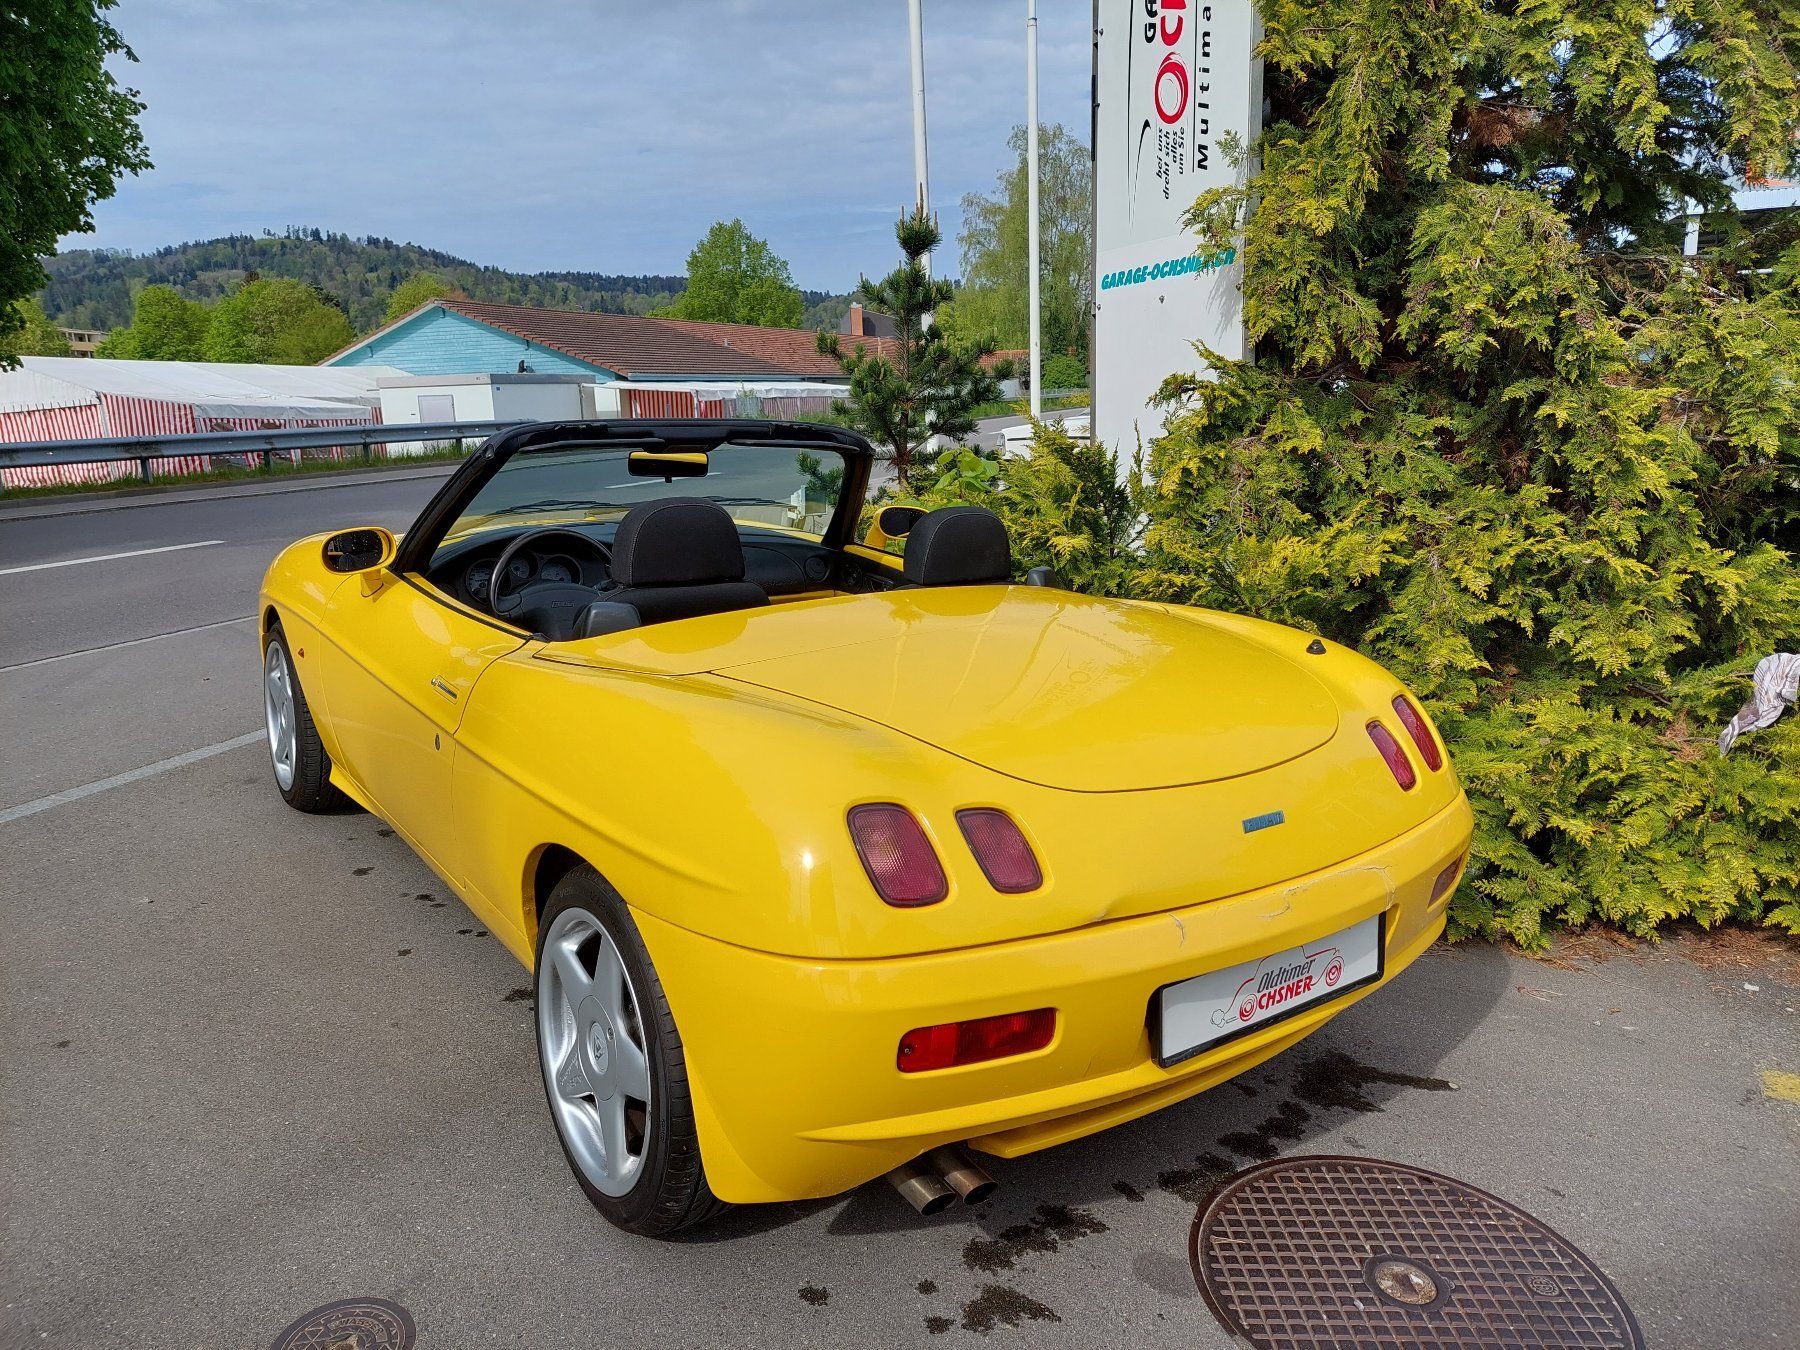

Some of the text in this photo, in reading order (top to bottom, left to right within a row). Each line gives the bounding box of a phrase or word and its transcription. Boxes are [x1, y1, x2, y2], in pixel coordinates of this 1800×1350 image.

[1197, 6, 1212, 170] Multima
[1179, 153, 1184, 175] um
[1257, 958, 1316, 993] Oldtimer
